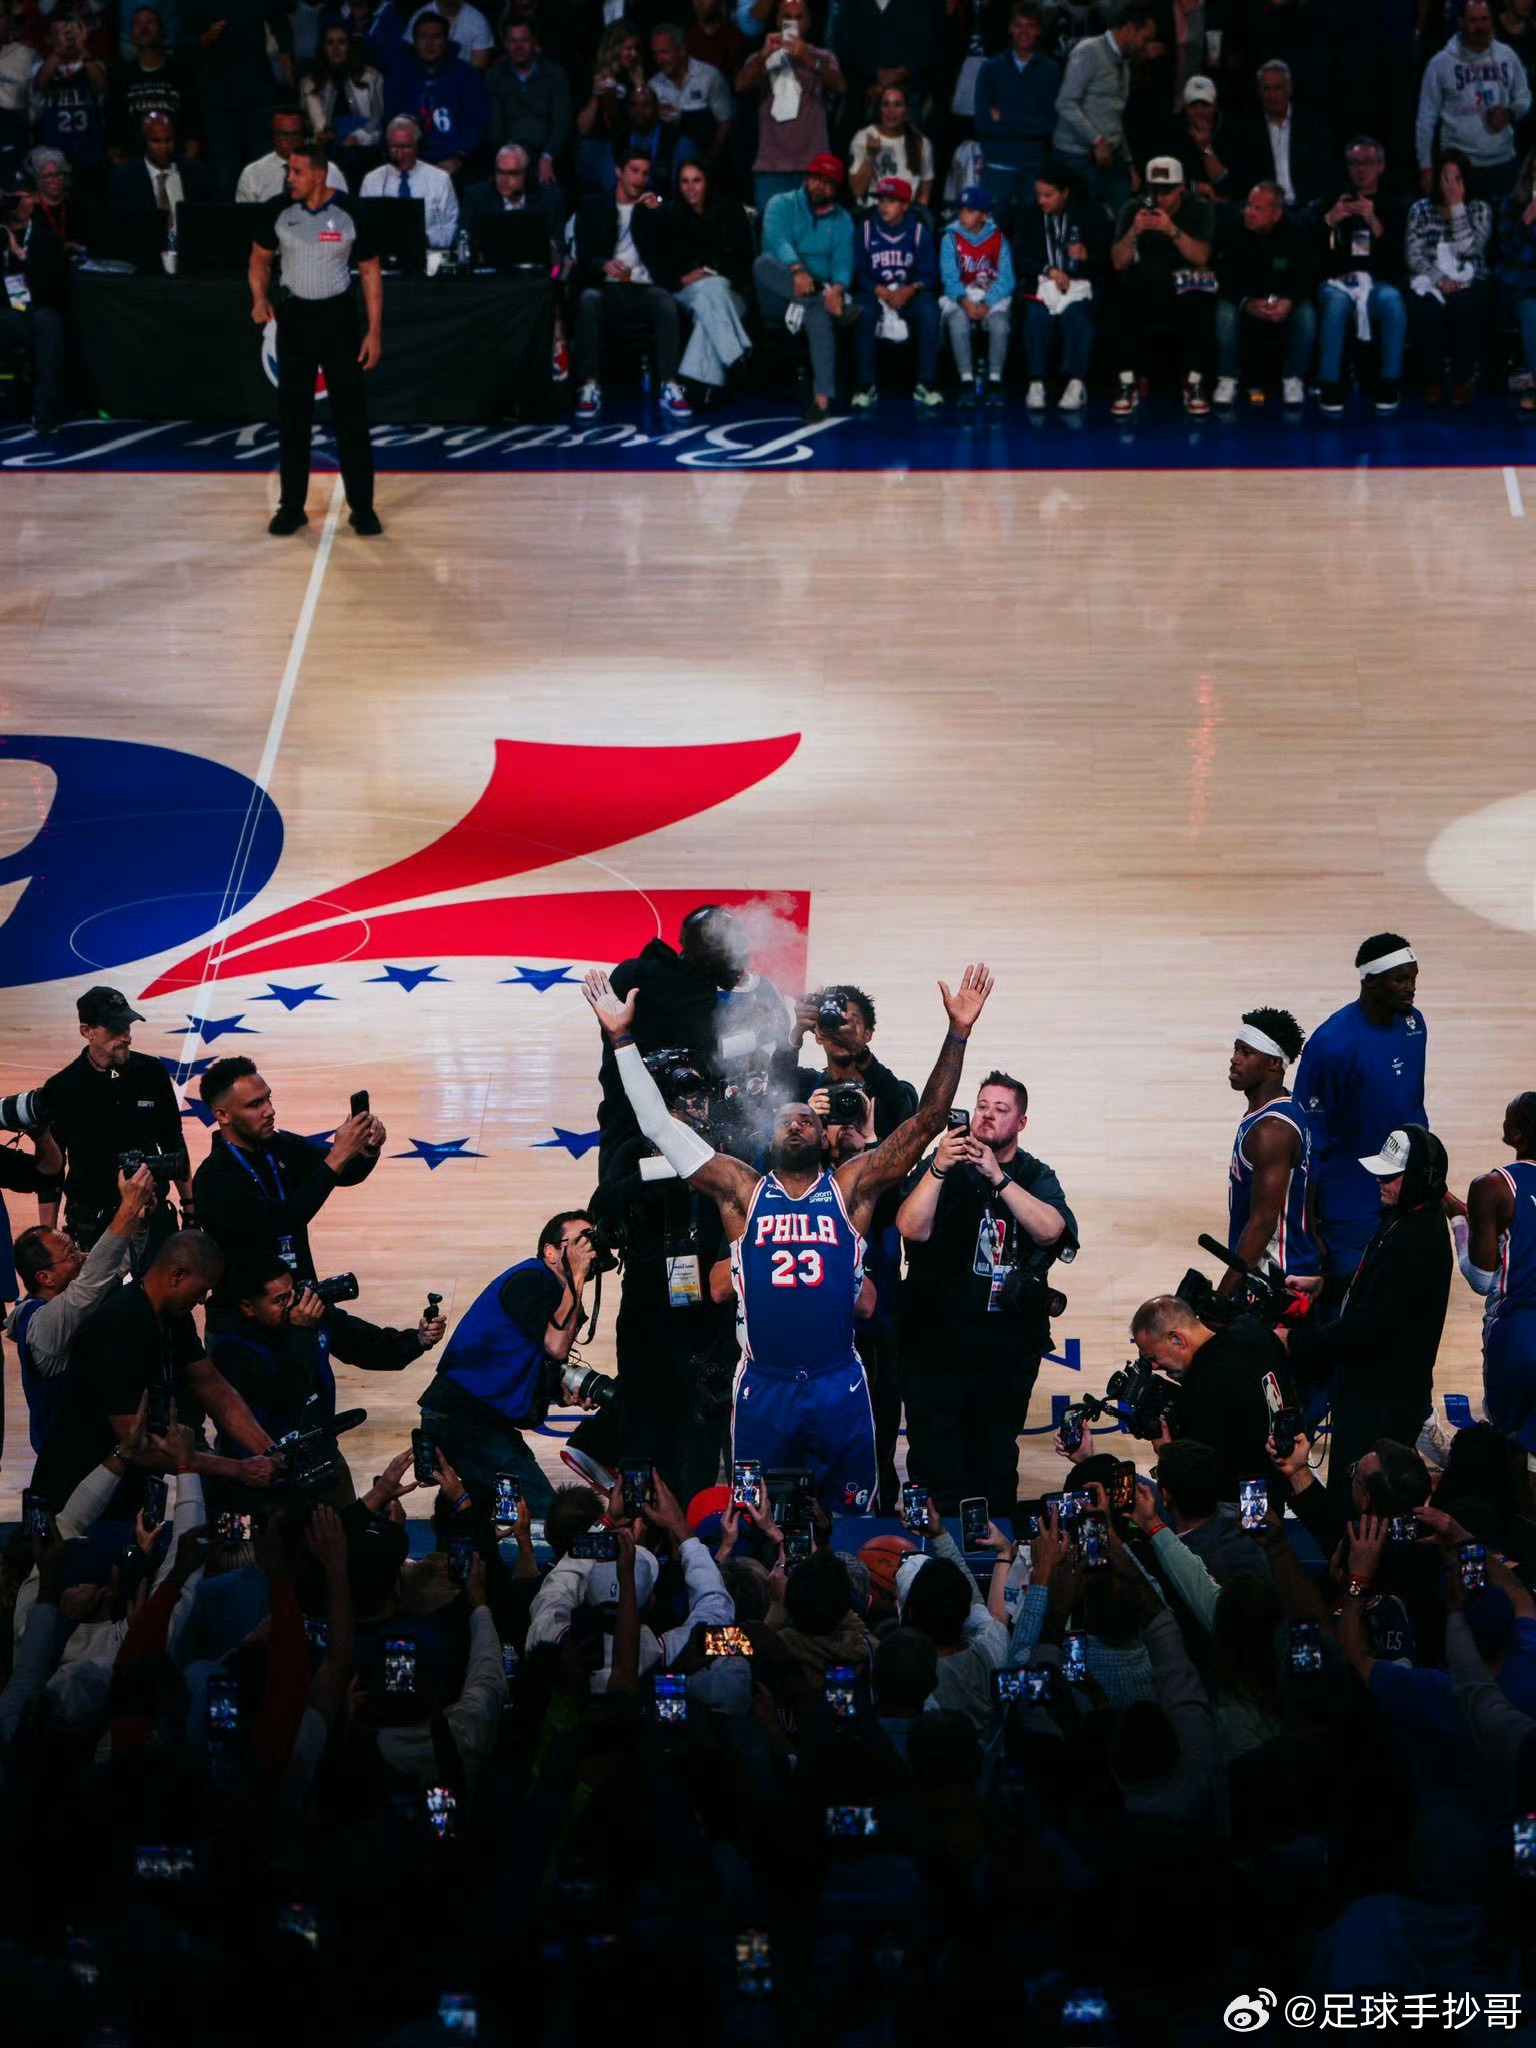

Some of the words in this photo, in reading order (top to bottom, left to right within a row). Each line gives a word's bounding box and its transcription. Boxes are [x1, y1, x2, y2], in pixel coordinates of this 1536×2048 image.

[57, 109, 89, 133] 23
[755, 1213, 839, 1246] PHILA
[771, 1249, 825, 1287] 23
[976, 1261, 991, 1273] NBA
[843, 1487, 869, 1506] 76
[1386, 1630, 1404, 1651] ES
